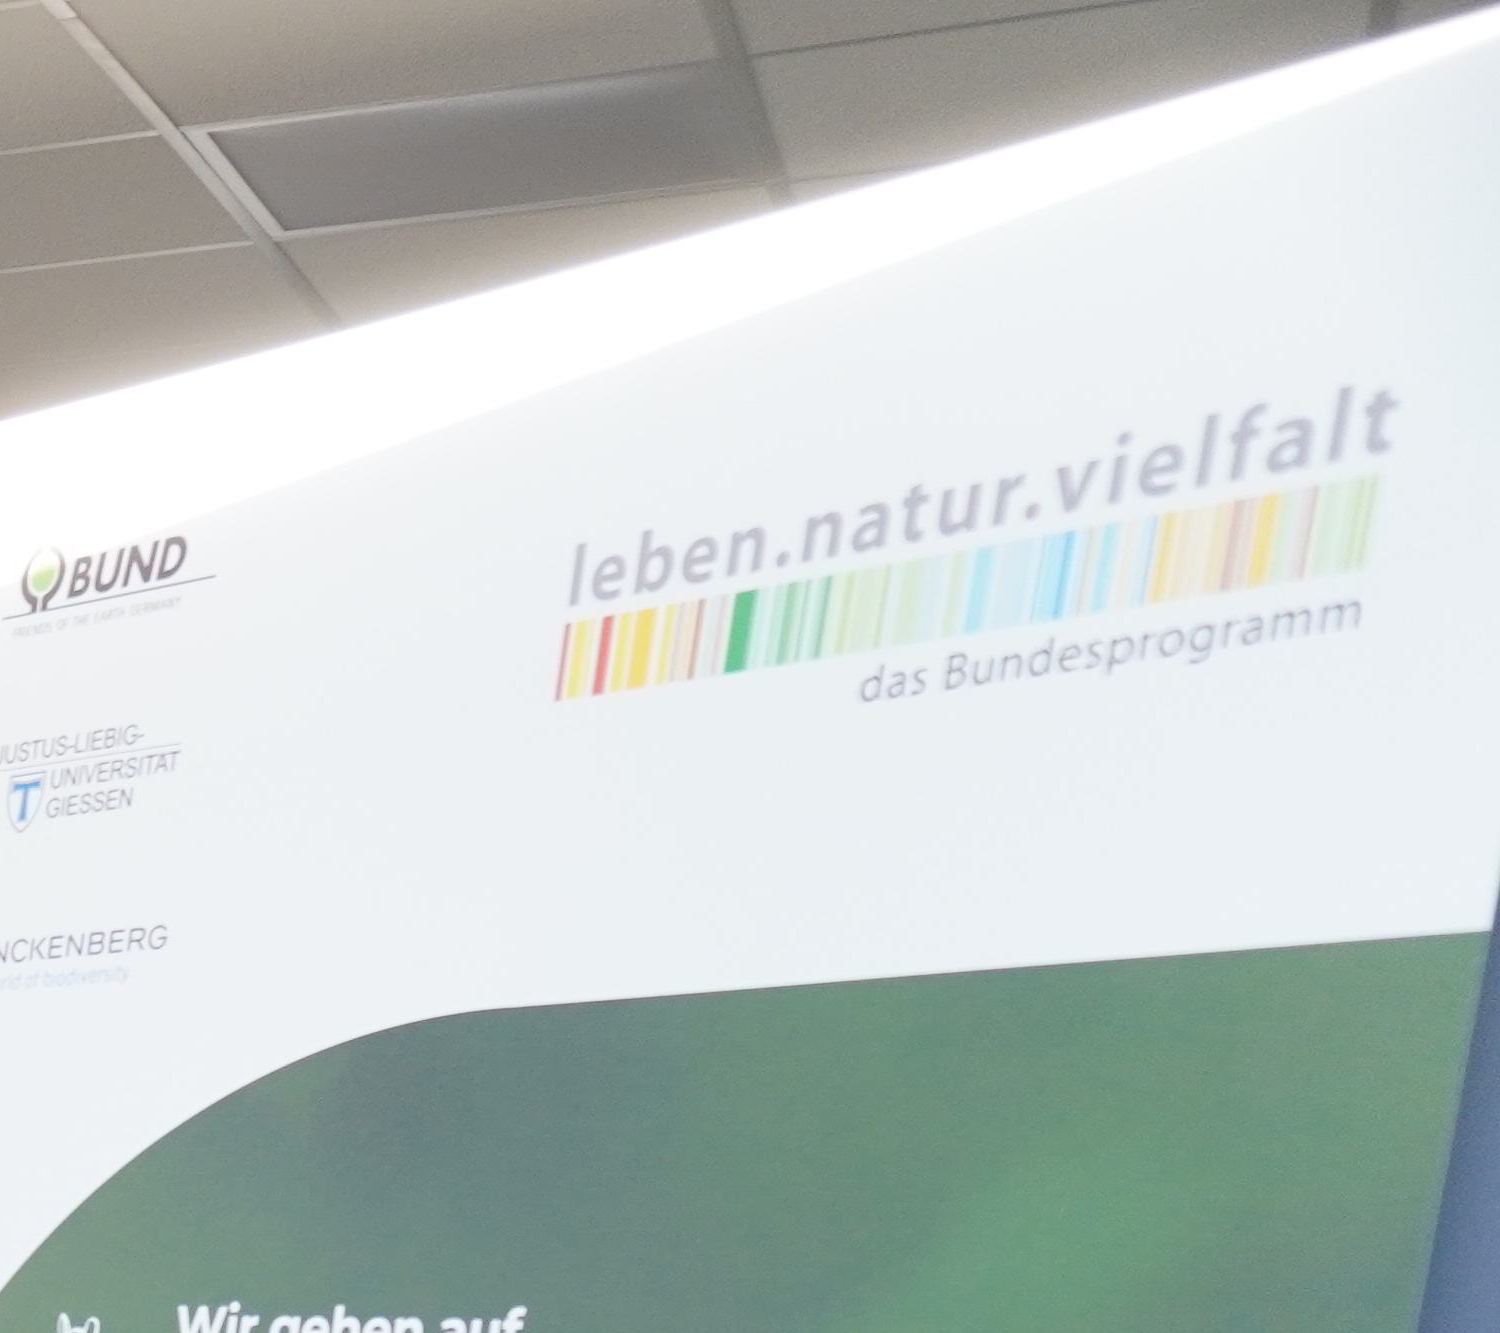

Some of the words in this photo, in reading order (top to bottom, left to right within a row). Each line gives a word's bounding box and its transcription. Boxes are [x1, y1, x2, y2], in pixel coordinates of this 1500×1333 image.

[568, 385, 1401, 606] leben.natur.vielfalt
[67, 536, 187, 599] BUND
[860, 665, 928, 704] das
[944, 598, 1364, 694] Bundesprogramm
[46, 787, 134, 818] GIESSEN
